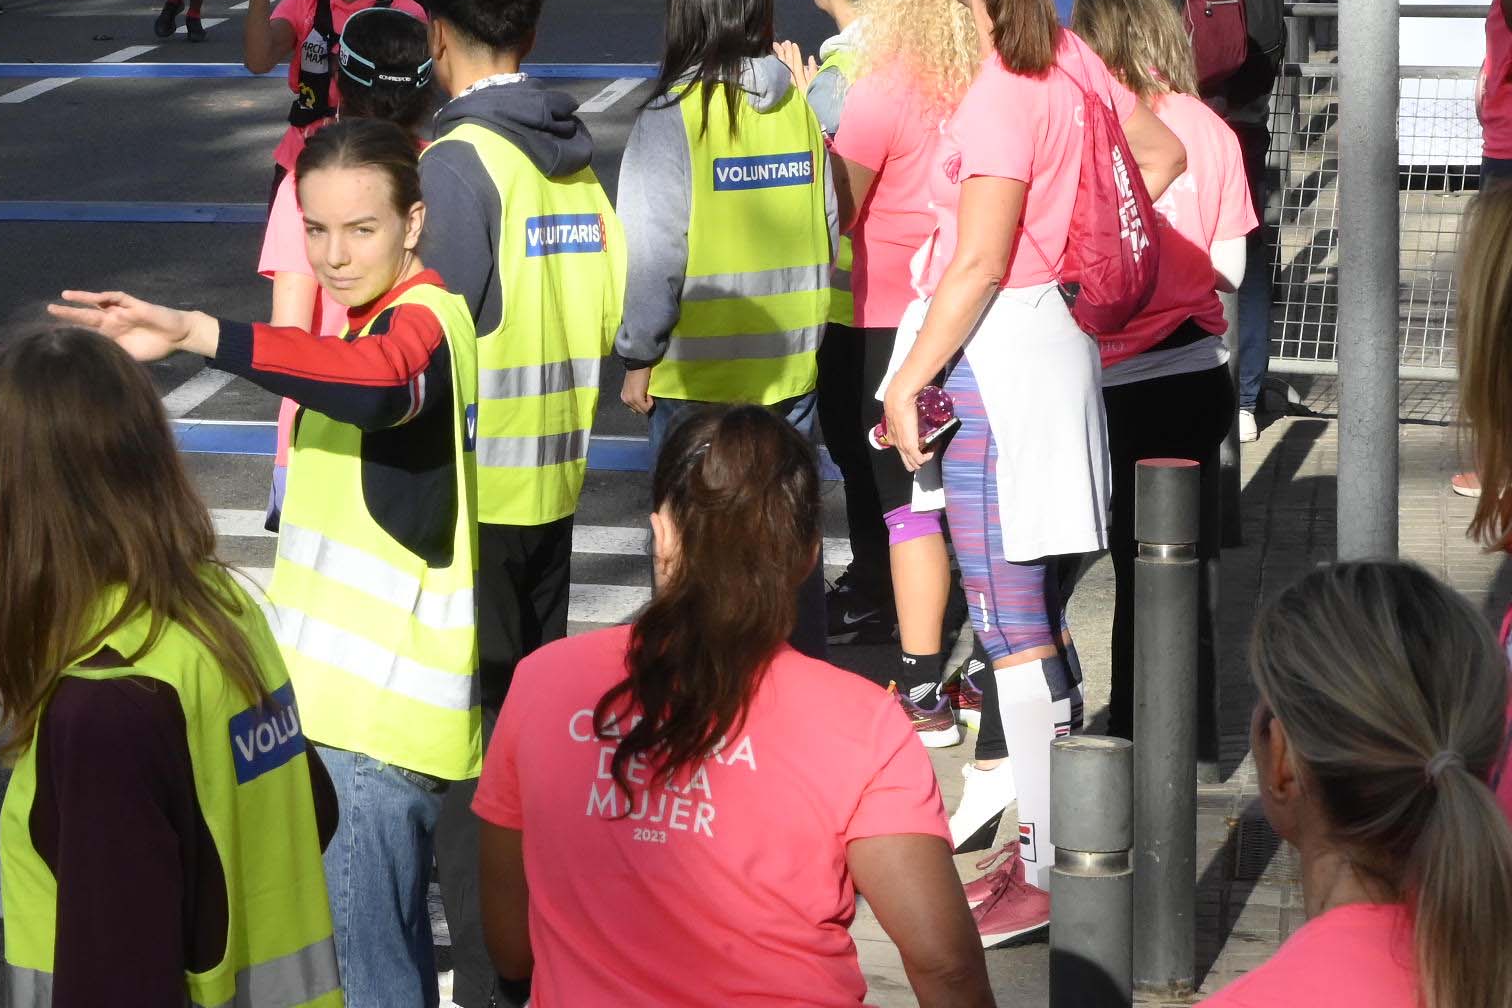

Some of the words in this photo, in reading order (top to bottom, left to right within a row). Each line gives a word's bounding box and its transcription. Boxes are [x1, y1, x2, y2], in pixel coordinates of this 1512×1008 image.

[306, 52, 324, 64] MAX
[717, 160, 811, 183] VOLUNTARIS
[586, 781, 715, 838] MUJER
[633, 828, 668, 843] 2023
